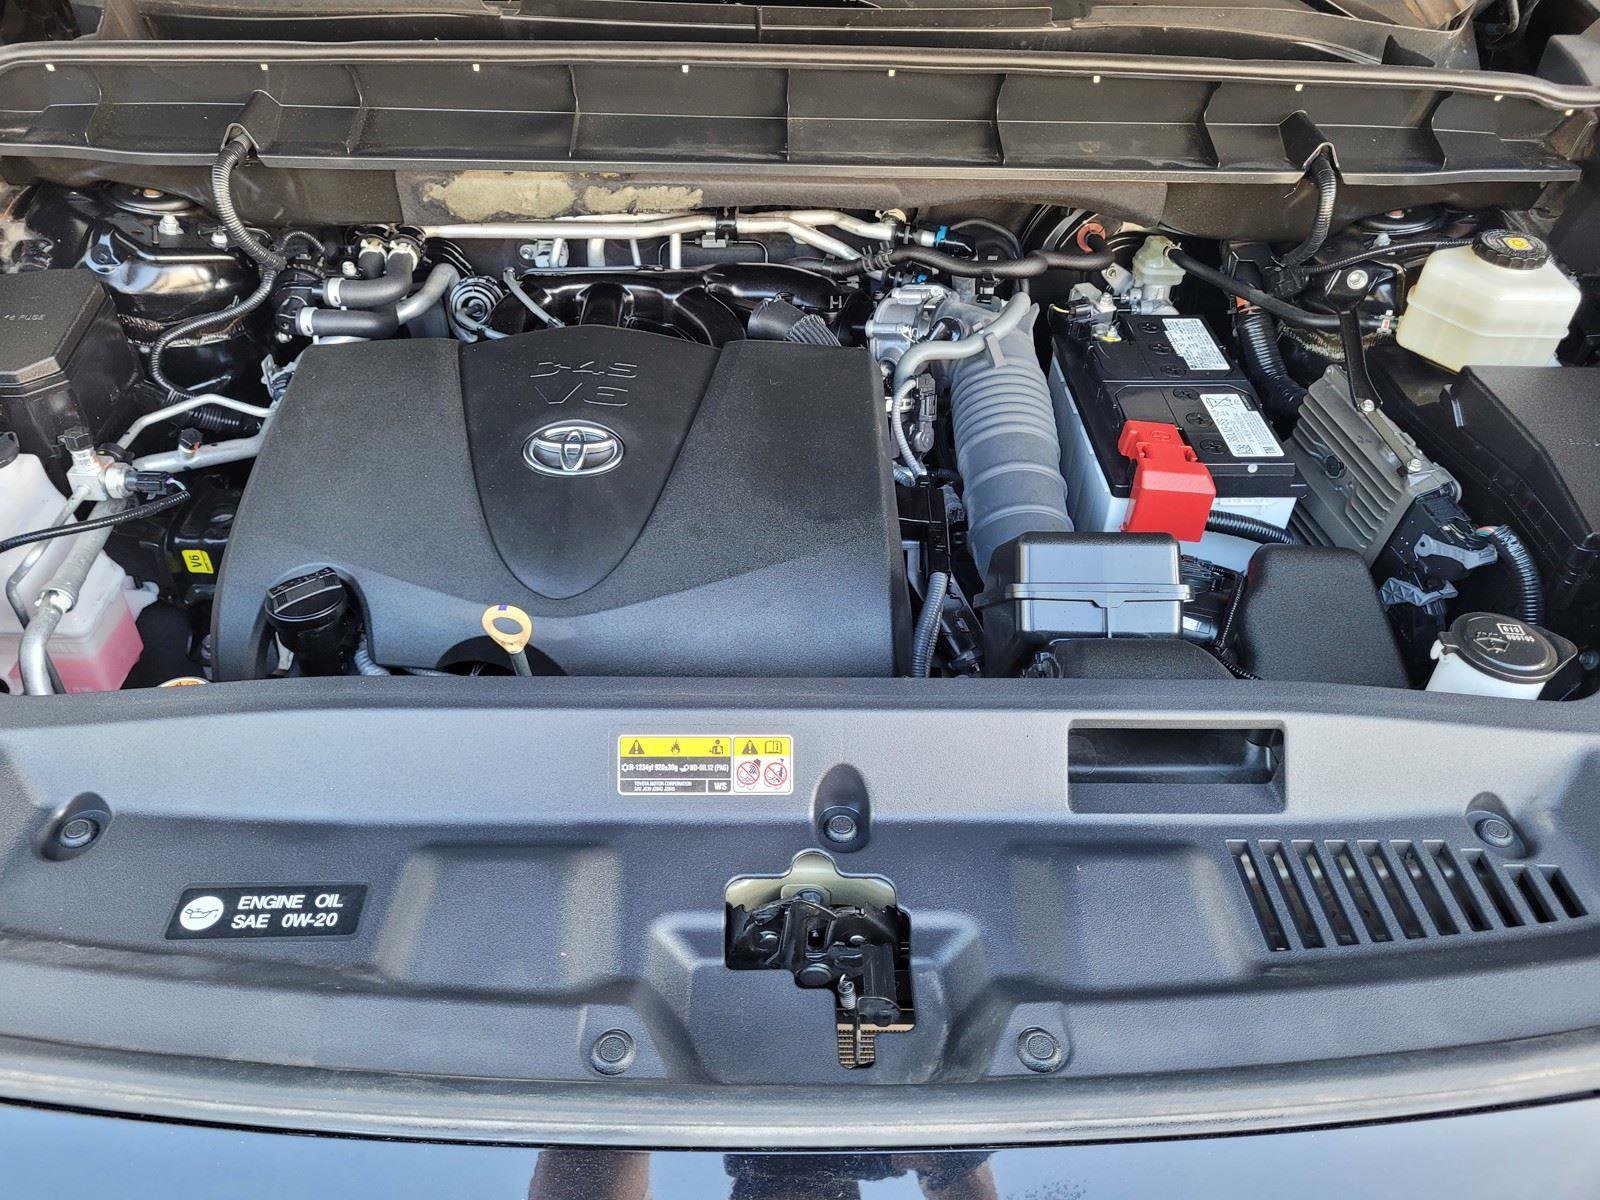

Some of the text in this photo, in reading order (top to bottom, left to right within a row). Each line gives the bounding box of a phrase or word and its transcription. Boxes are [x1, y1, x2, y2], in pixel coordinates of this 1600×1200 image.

[534, 381, 629, 407] V6
[713, 781, 728, 791] WS
[237, 893, 344, 910] ENGINE OIL
[230, 912, 338, 929] SAE 0W-20
